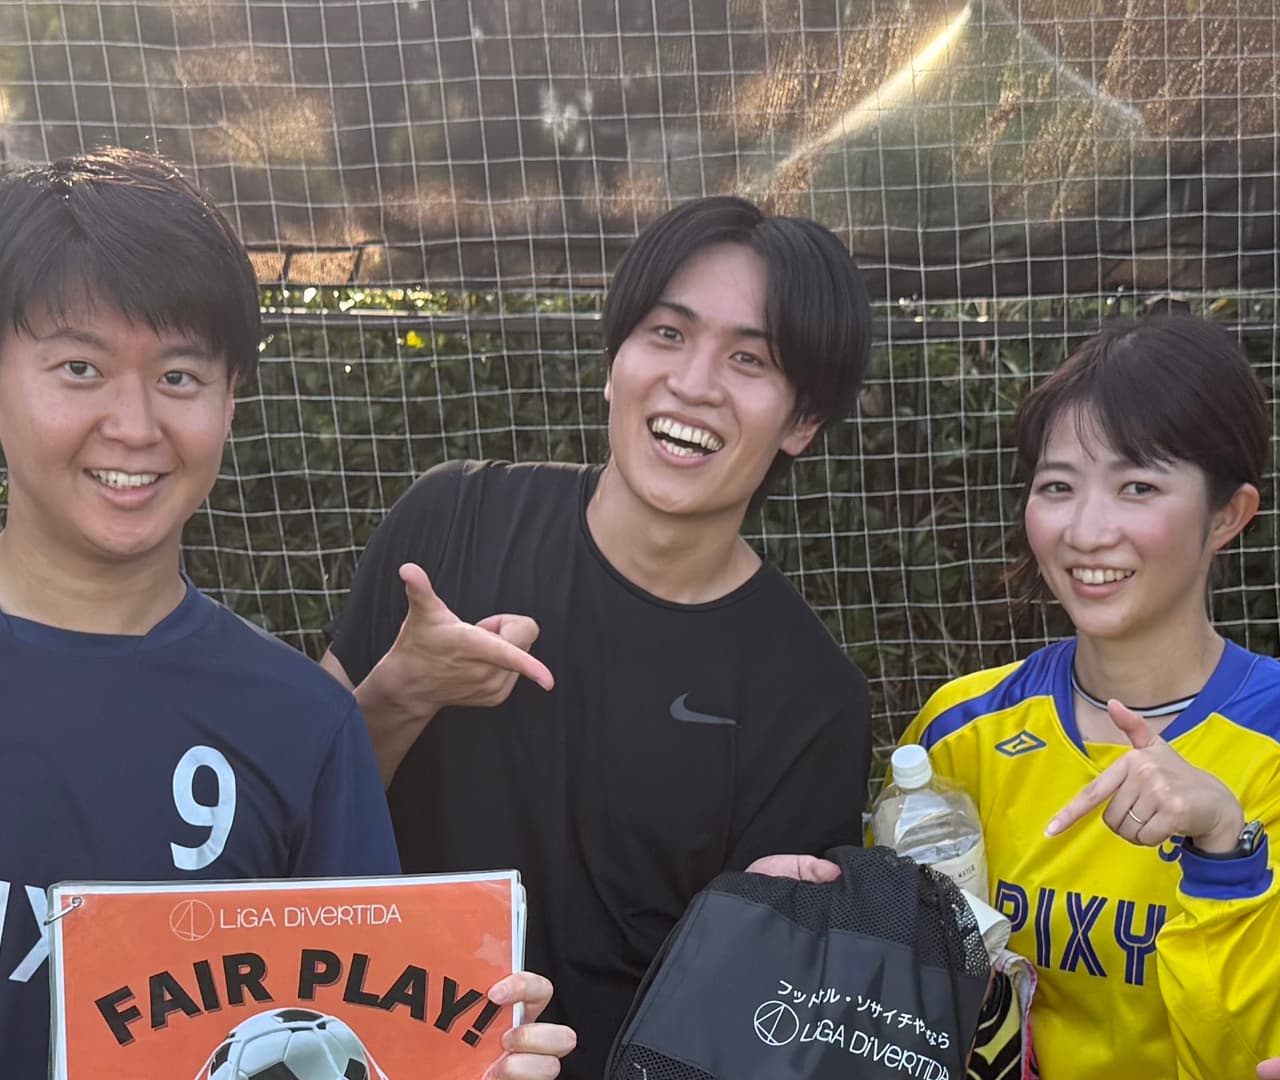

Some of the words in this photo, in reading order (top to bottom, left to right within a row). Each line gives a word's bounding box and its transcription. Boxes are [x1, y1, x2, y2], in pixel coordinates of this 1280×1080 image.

[170, 745, 237, 870] 9
[995, 879, 1167, 986] PIXY
[95, 951, 274, 1047] FAIR
[297, 949, 504, 1048] PLAY!
